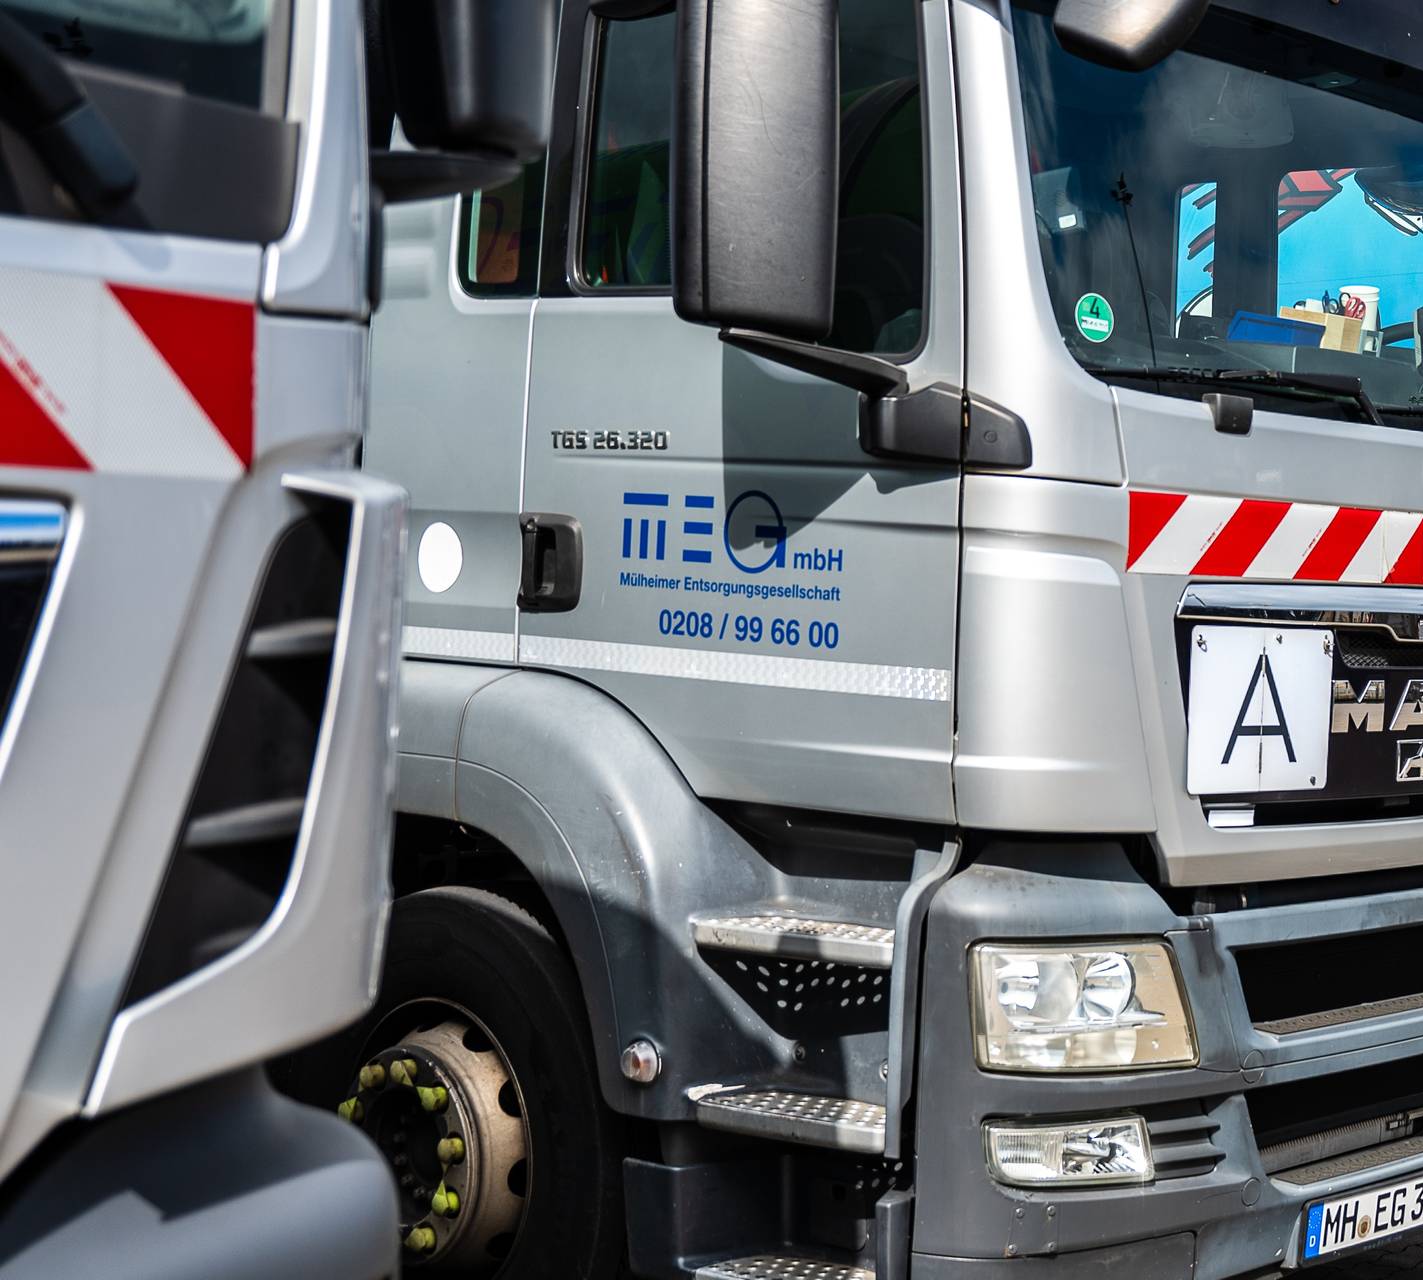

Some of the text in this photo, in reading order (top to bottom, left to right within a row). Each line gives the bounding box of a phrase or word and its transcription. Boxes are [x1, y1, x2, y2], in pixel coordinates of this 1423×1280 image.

[1090, 298, 1100, 319] 4
[551, 430, 670, 450] TGS 26.320
[622, 490, 843, 574] MEG mbH
[619, 571, 841, 601] Mülheimer Entsorgungsgesellschaft
[659, 608, 839, 649] 0208 / 99 66 00
[1221, 653, 1297, 764] A
[1323, 1200, 1360, 1247] MH
[1374, 1187, 1407, 1233] EG
[1309, 1235, 1316, 1248] D
